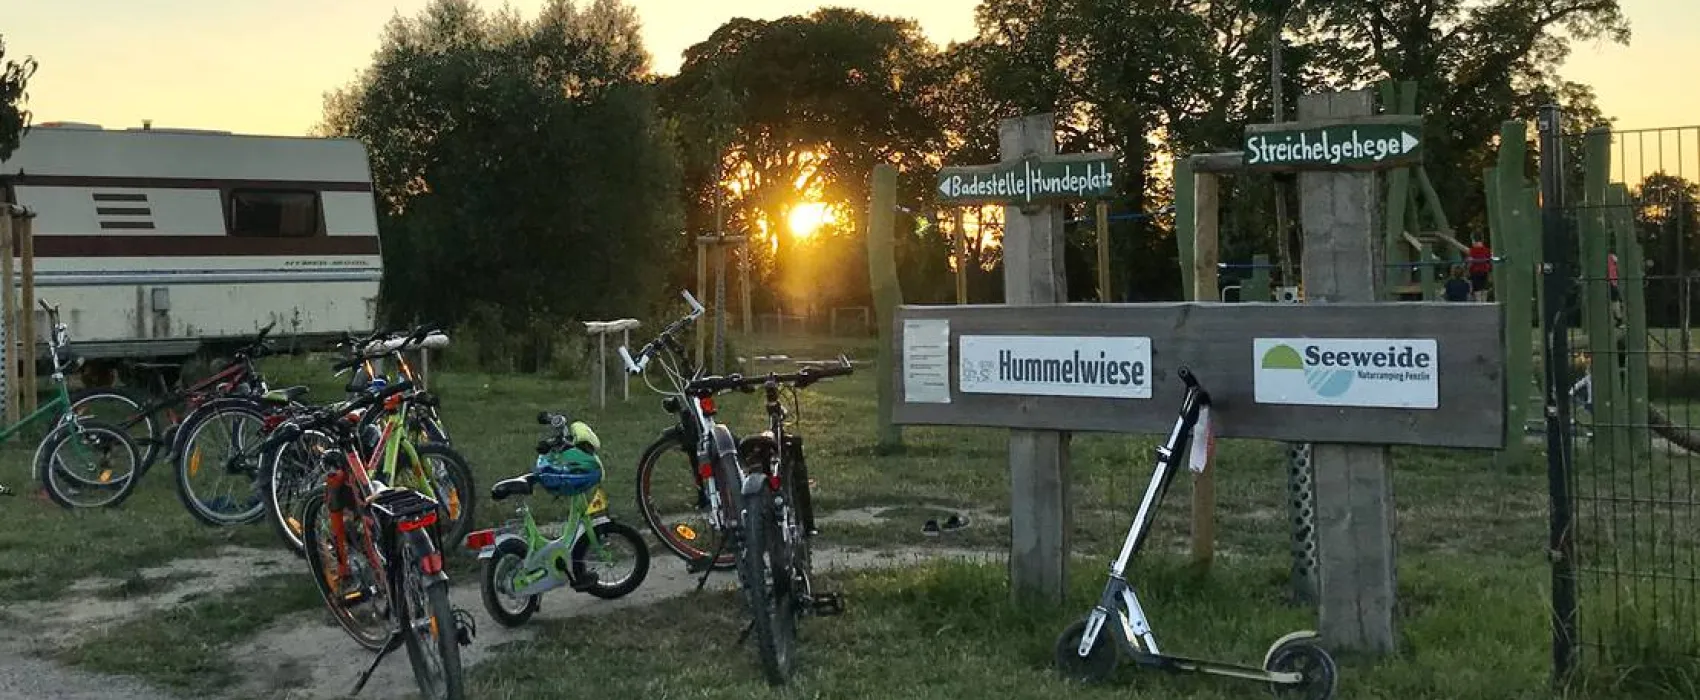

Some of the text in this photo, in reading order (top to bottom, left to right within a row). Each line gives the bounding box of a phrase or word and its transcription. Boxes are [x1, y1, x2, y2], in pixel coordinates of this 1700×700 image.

[1247, 130, 1400, 164] Streichelgehege
[952, 161, 1113, 197] Badestelle Hundeplatz
[1000, 350, 1144, 385] Hummelwiese
[1305, 345, 1430, 368] Seeweide
